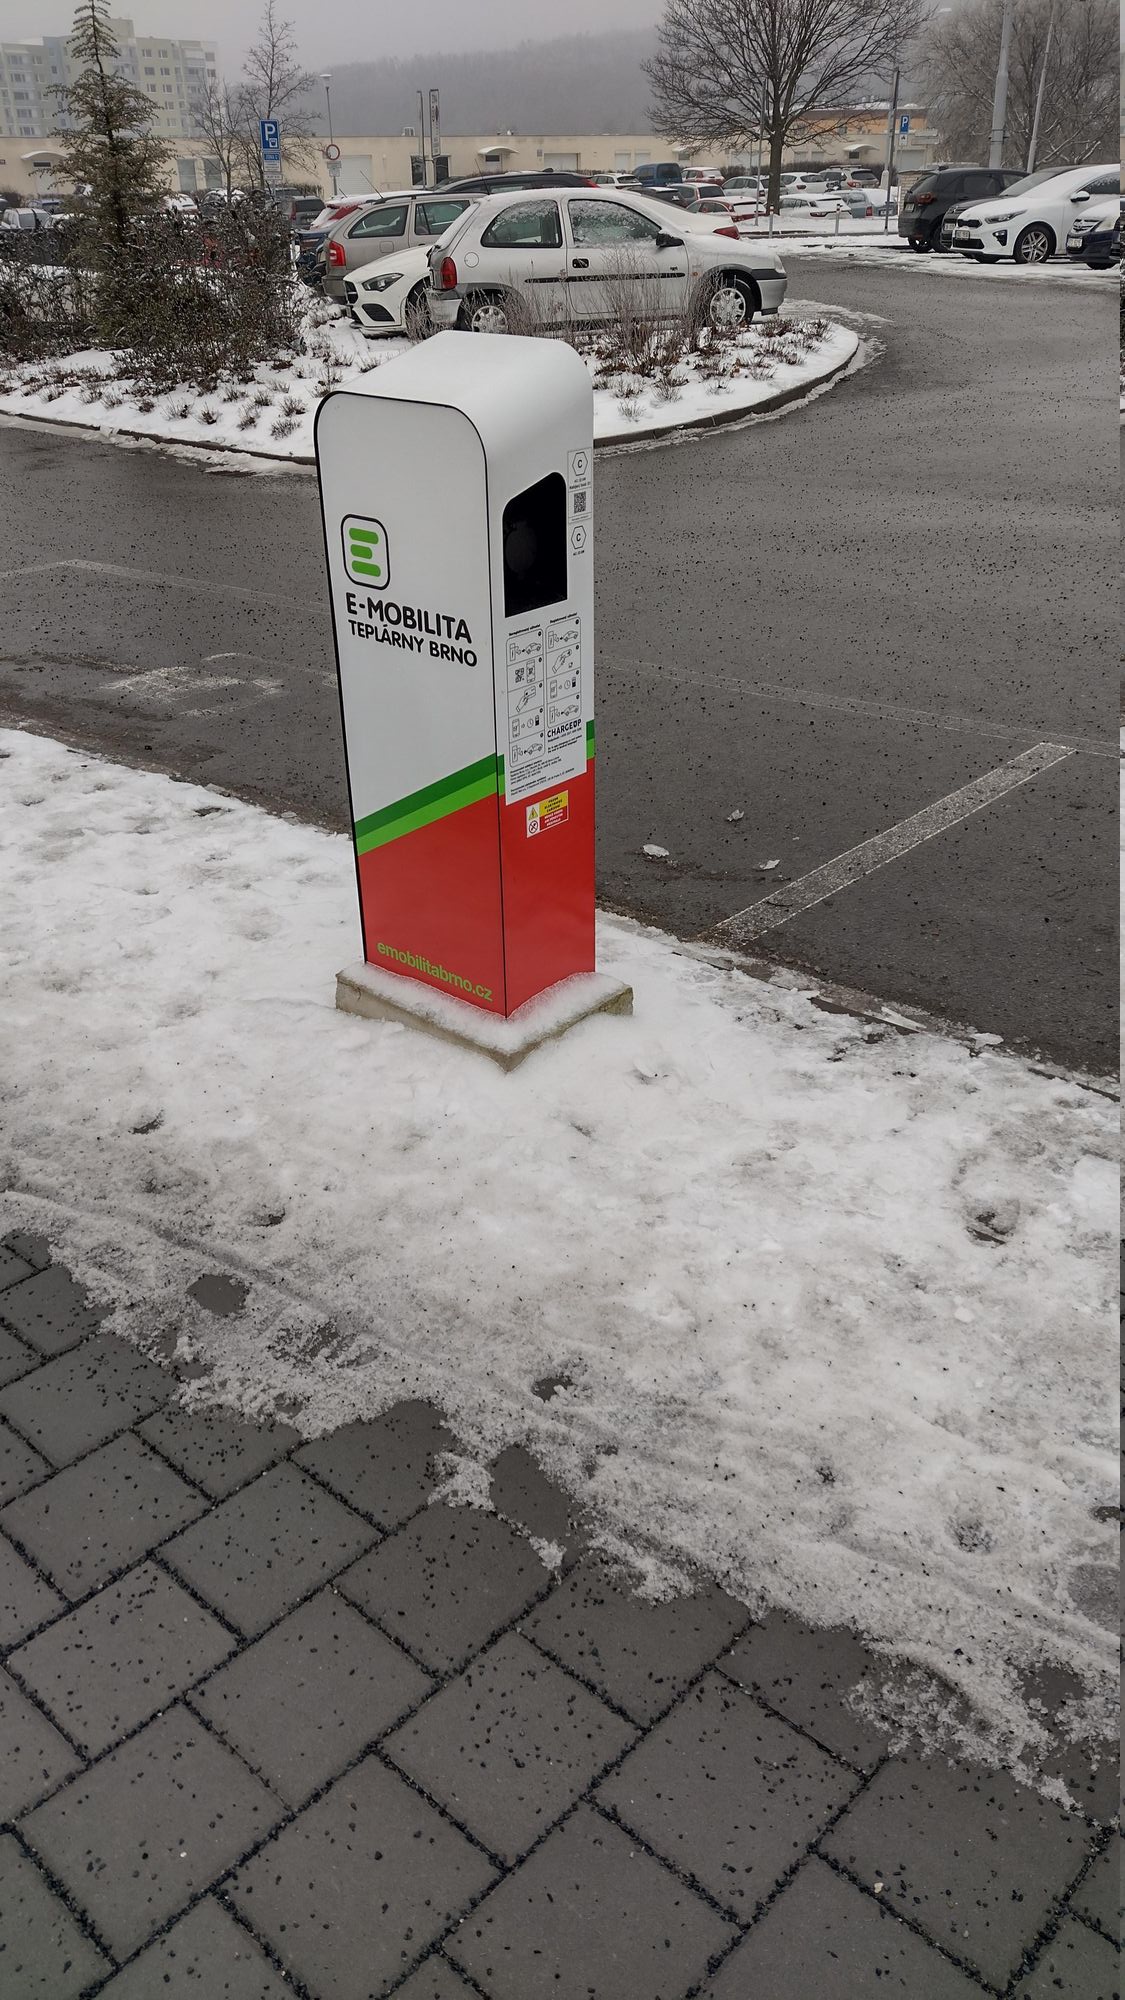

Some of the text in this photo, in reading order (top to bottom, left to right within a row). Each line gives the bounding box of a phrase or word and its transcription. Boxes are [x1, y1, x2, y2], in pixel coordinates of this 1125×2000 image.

[264, 123, 276, 141] P
[902, 116, 908, 128] P
[346, 592, 472, 644] E-MOBILITA
[348, 619, 477, 667] TEPLÁRNY BRNO
[377, 942, 493, 1002] emobilitabrno.cz
